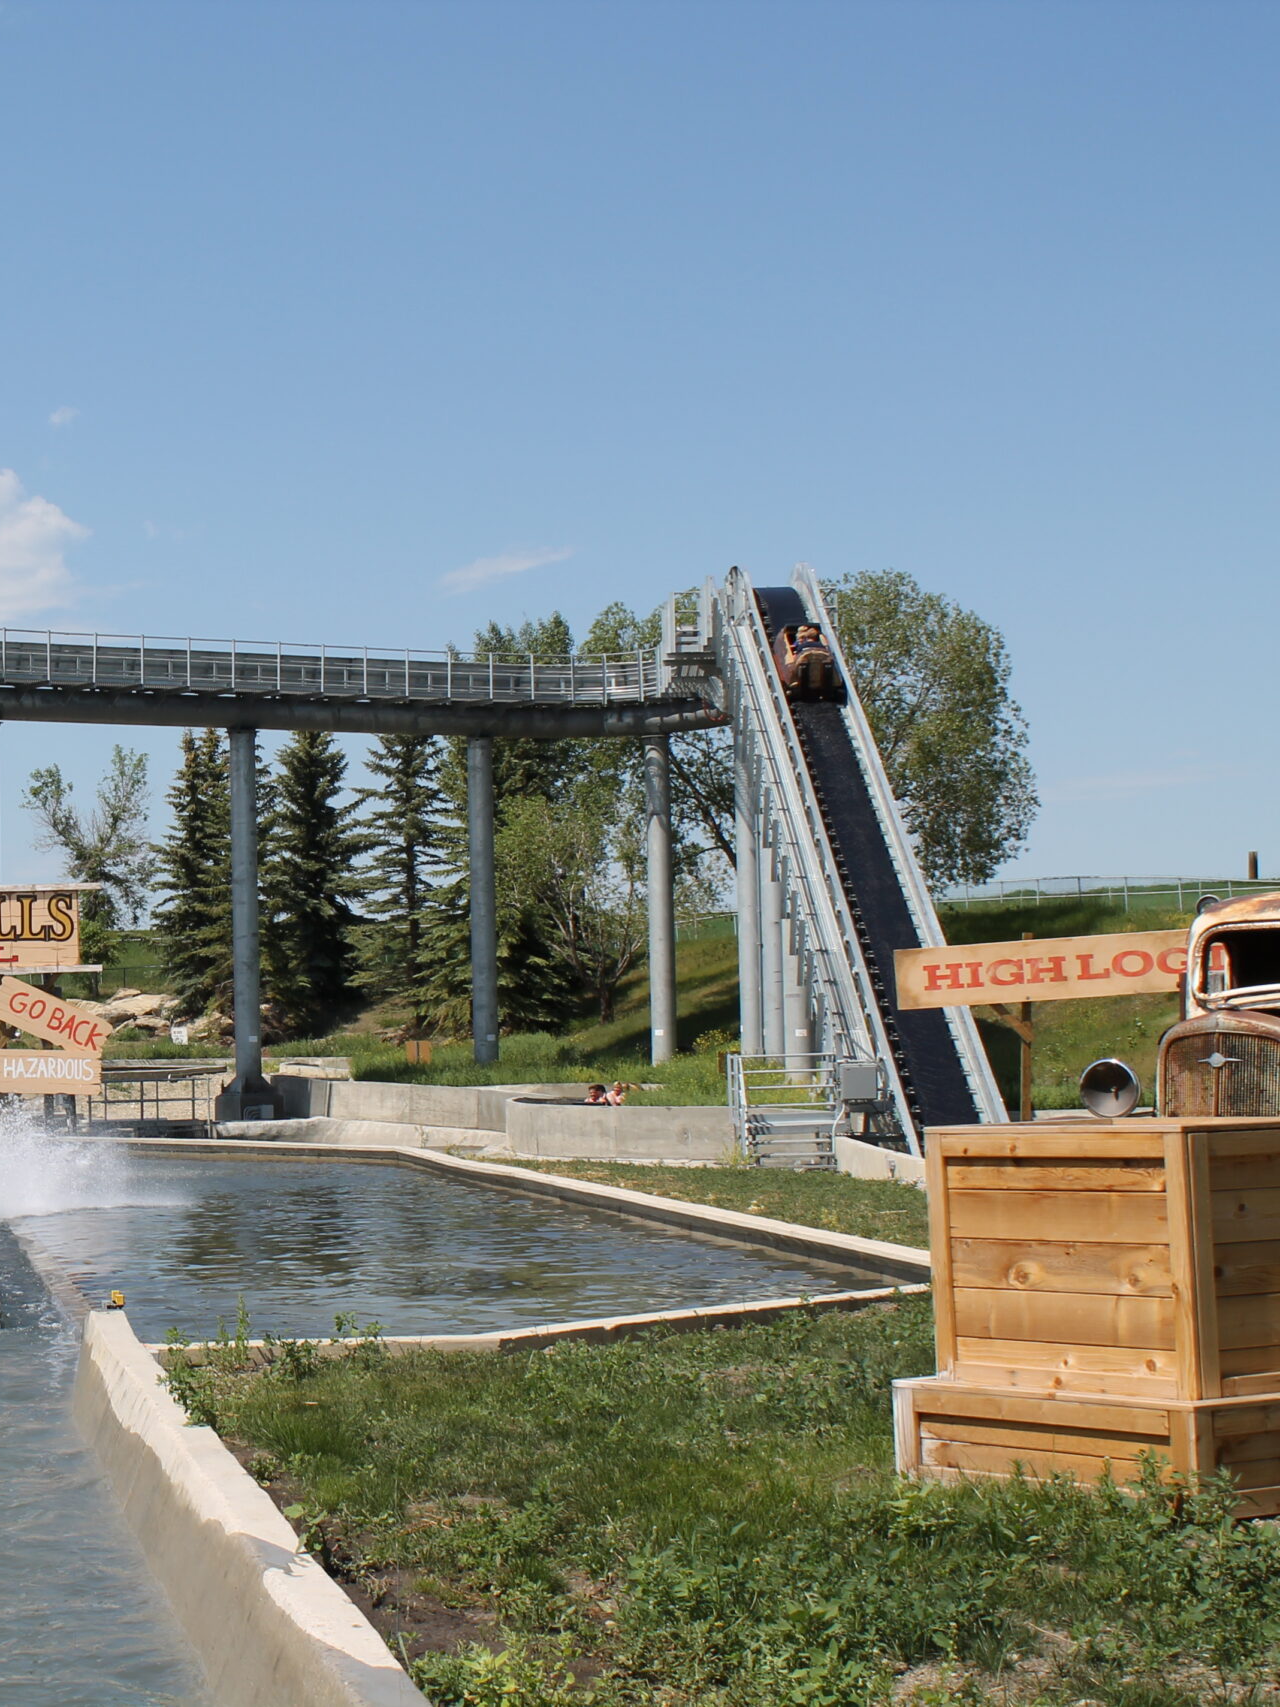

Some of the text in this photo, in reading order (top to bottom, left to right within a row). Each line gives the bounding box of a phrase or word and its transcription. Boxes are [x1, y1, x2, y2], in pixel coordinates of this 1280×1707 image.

[922, 955, 1068, 991] HIGH
[1076, 948, 1187, 980] LOG
[9, 992, 103, 1051] GO BACK
[3, 1057, 95, 1081] HAZARDOUS
